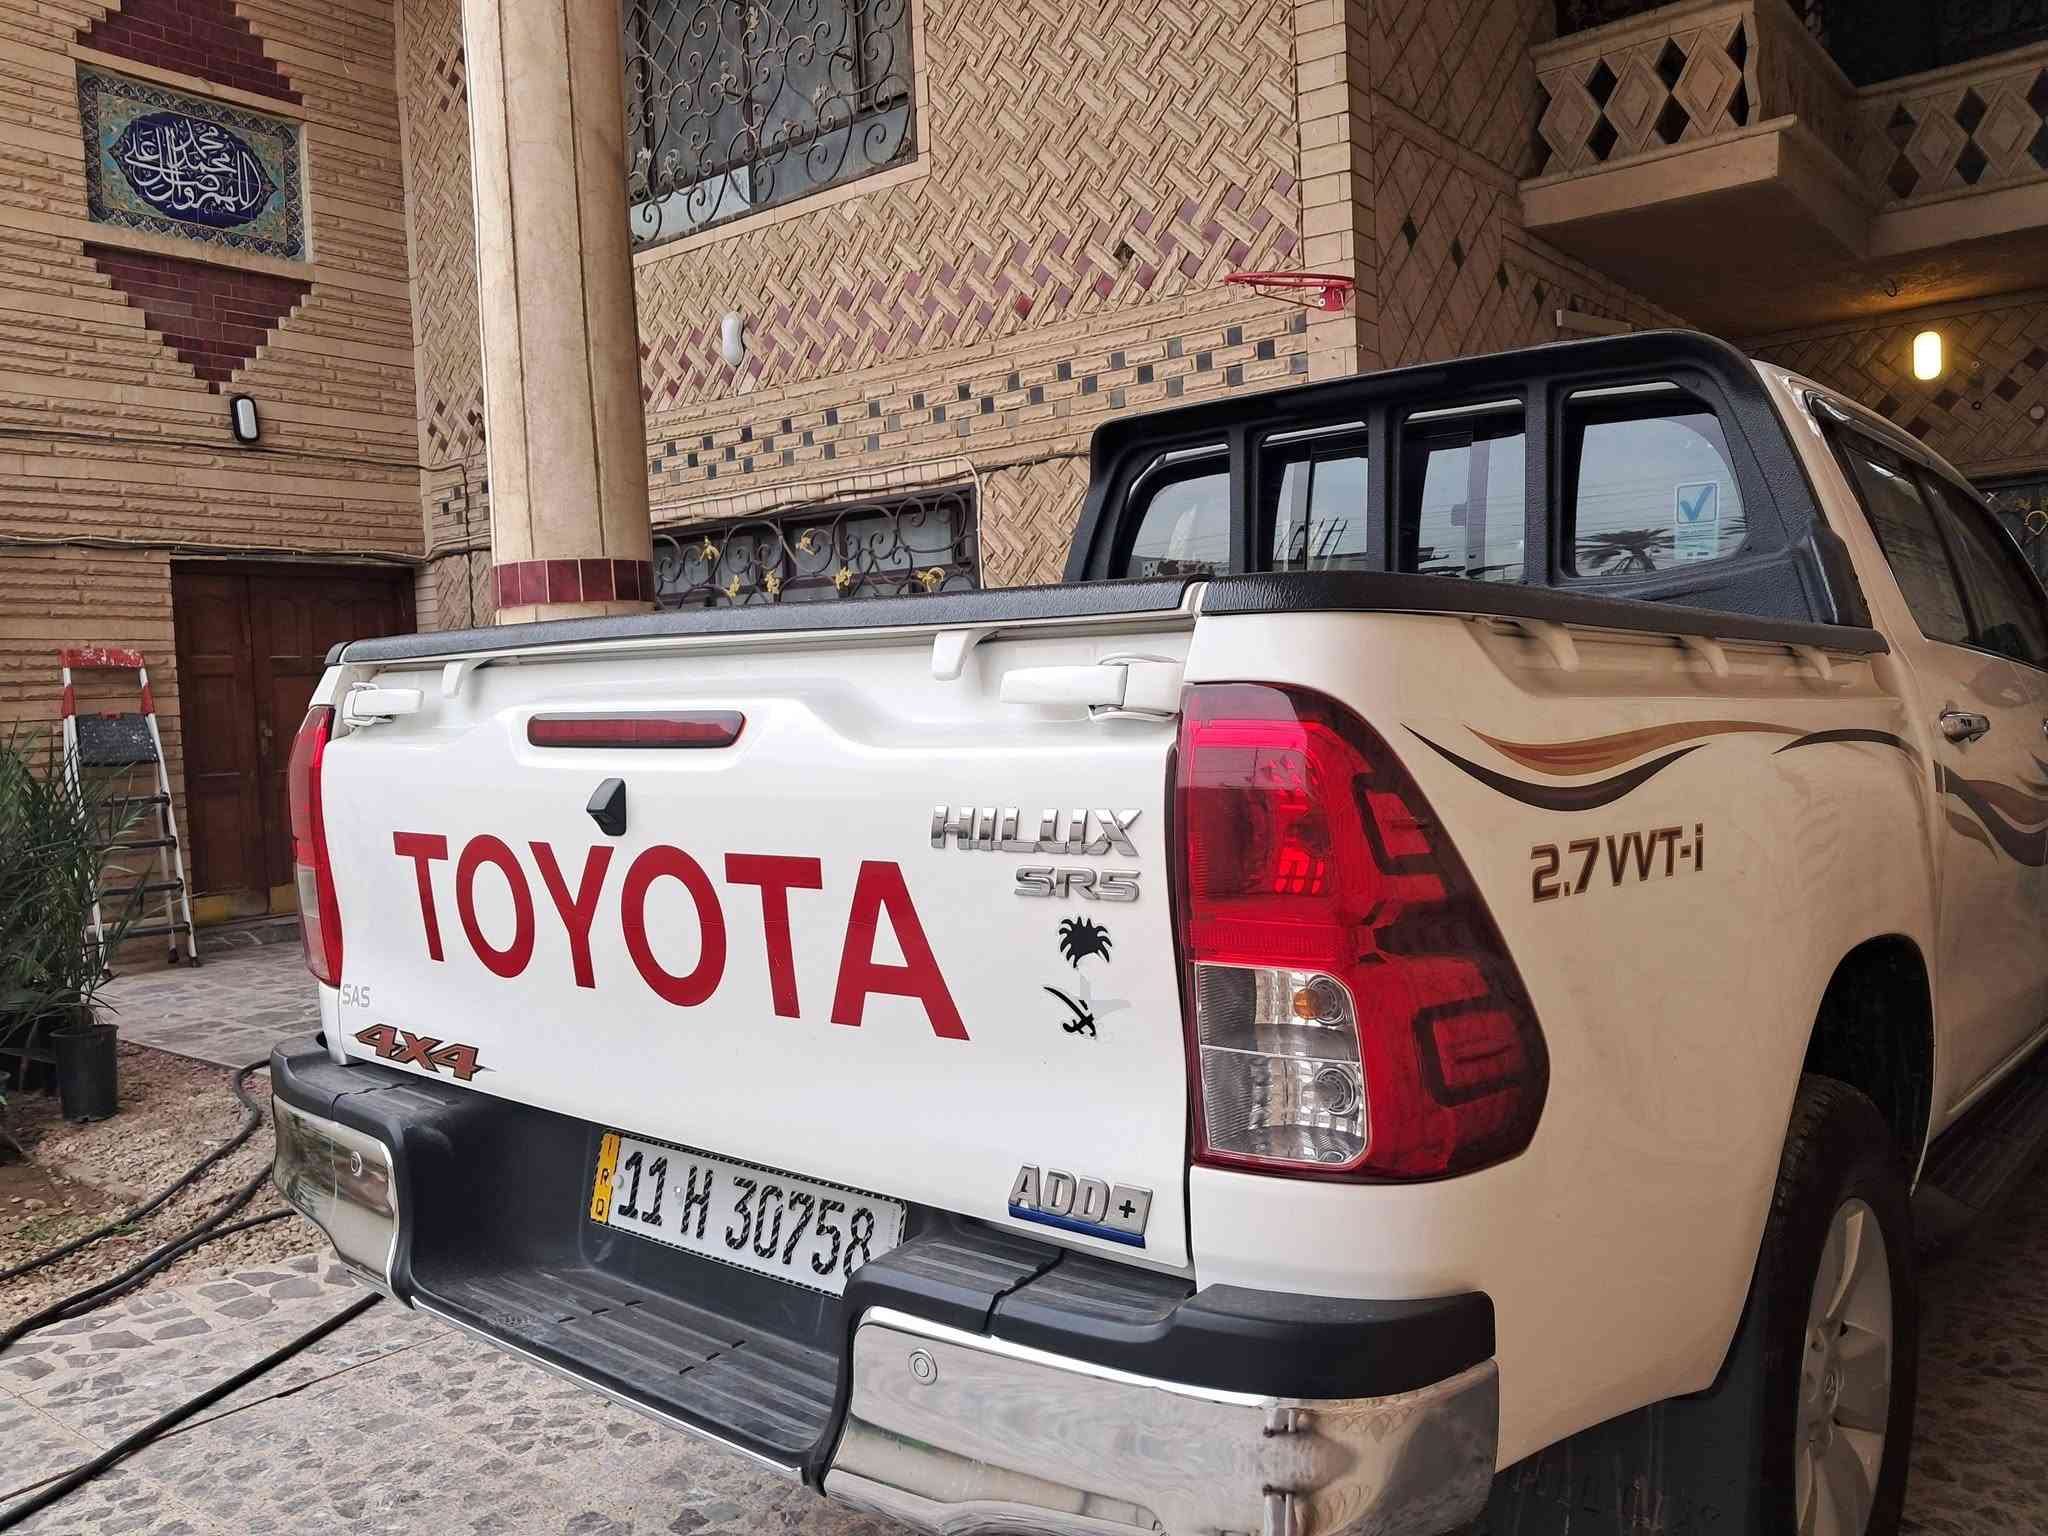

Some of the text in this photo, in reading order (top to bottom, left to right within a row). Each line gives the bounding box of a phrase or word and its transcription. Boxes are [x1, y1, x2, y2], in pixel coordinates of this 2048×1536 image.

[931, 805, 1142, 857] HILUX
[1013, 864, 1141, 902] SR5
[392, 831, 970, 1041] TOYOTA
[617, 1151, 669, 1227] 11
[681, 1166, 713, 1240] H
[725, 1177, 876, 1278] 30758
